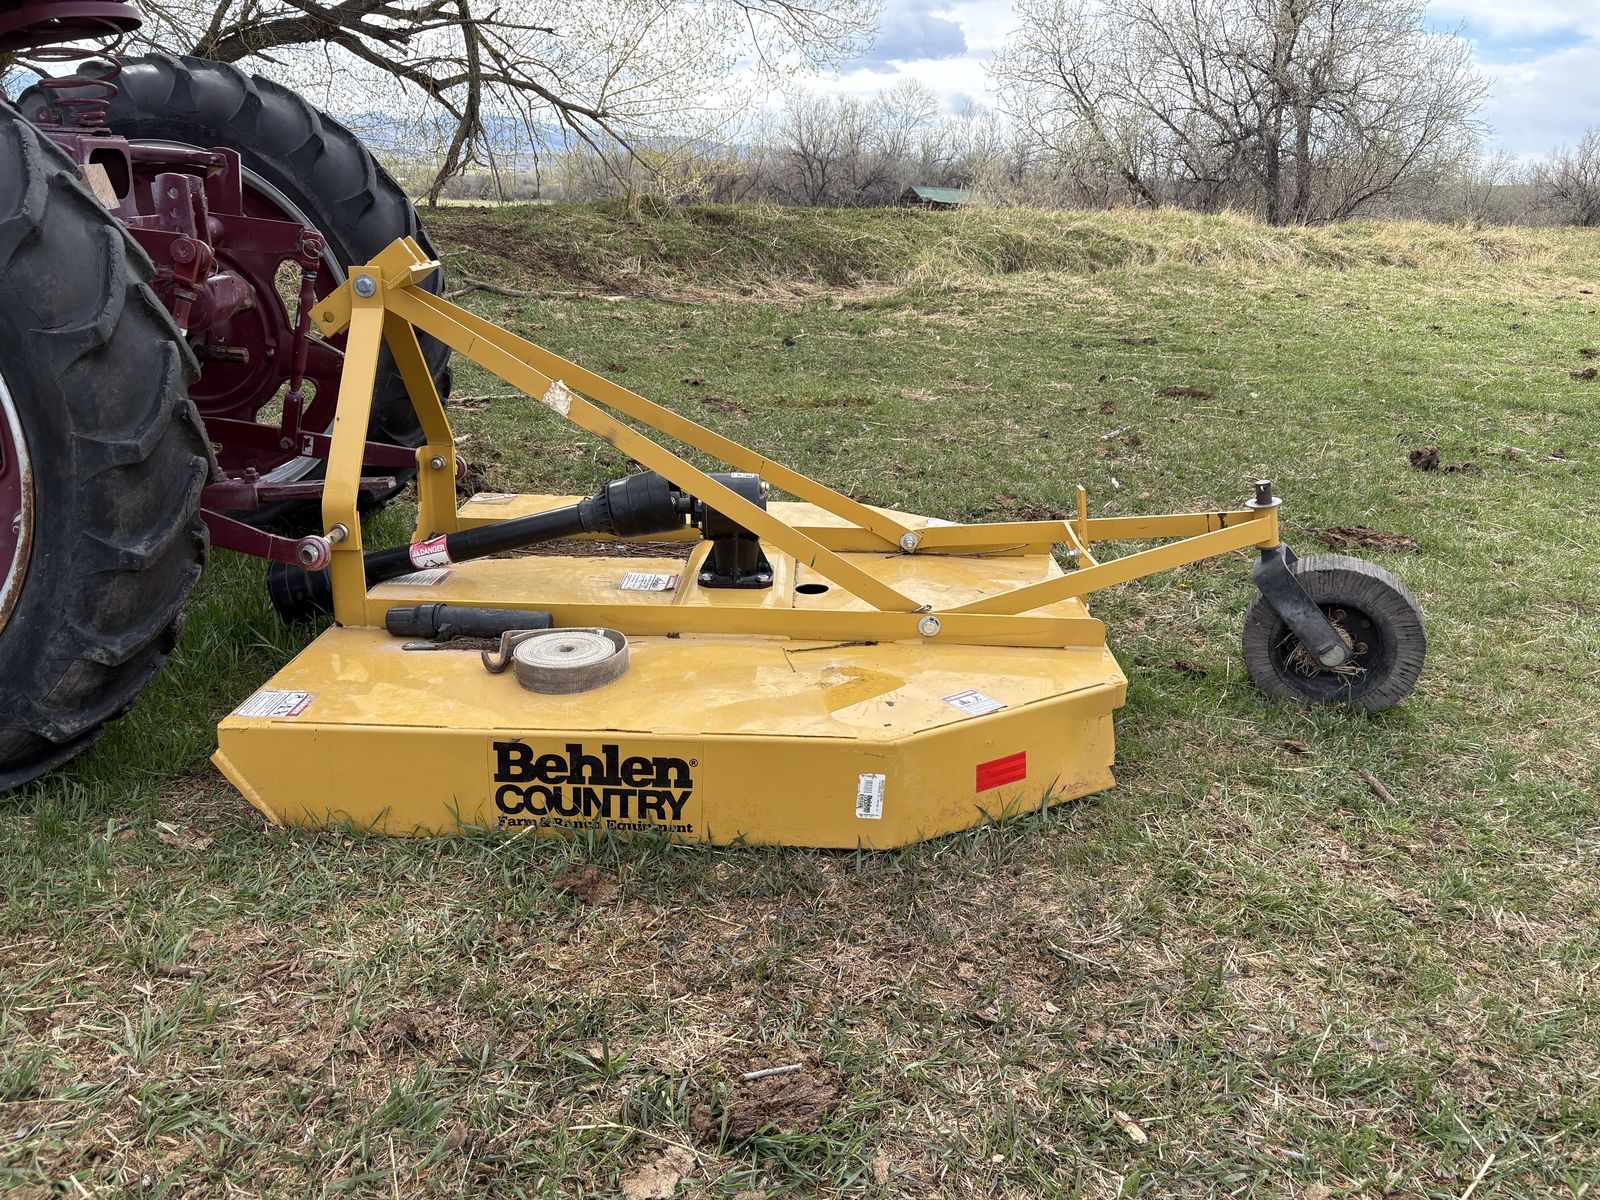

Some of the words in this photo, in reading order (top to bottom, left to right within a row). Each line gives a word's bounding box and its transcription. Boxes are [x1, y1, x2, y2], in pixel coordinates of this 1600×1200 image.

[420, 544, 446, 556] DANGER
[495, 784, 693, 821] COUNTRY
[498, 815, 537, 828] Farm
[553, 817, 603, 830] Ranch
